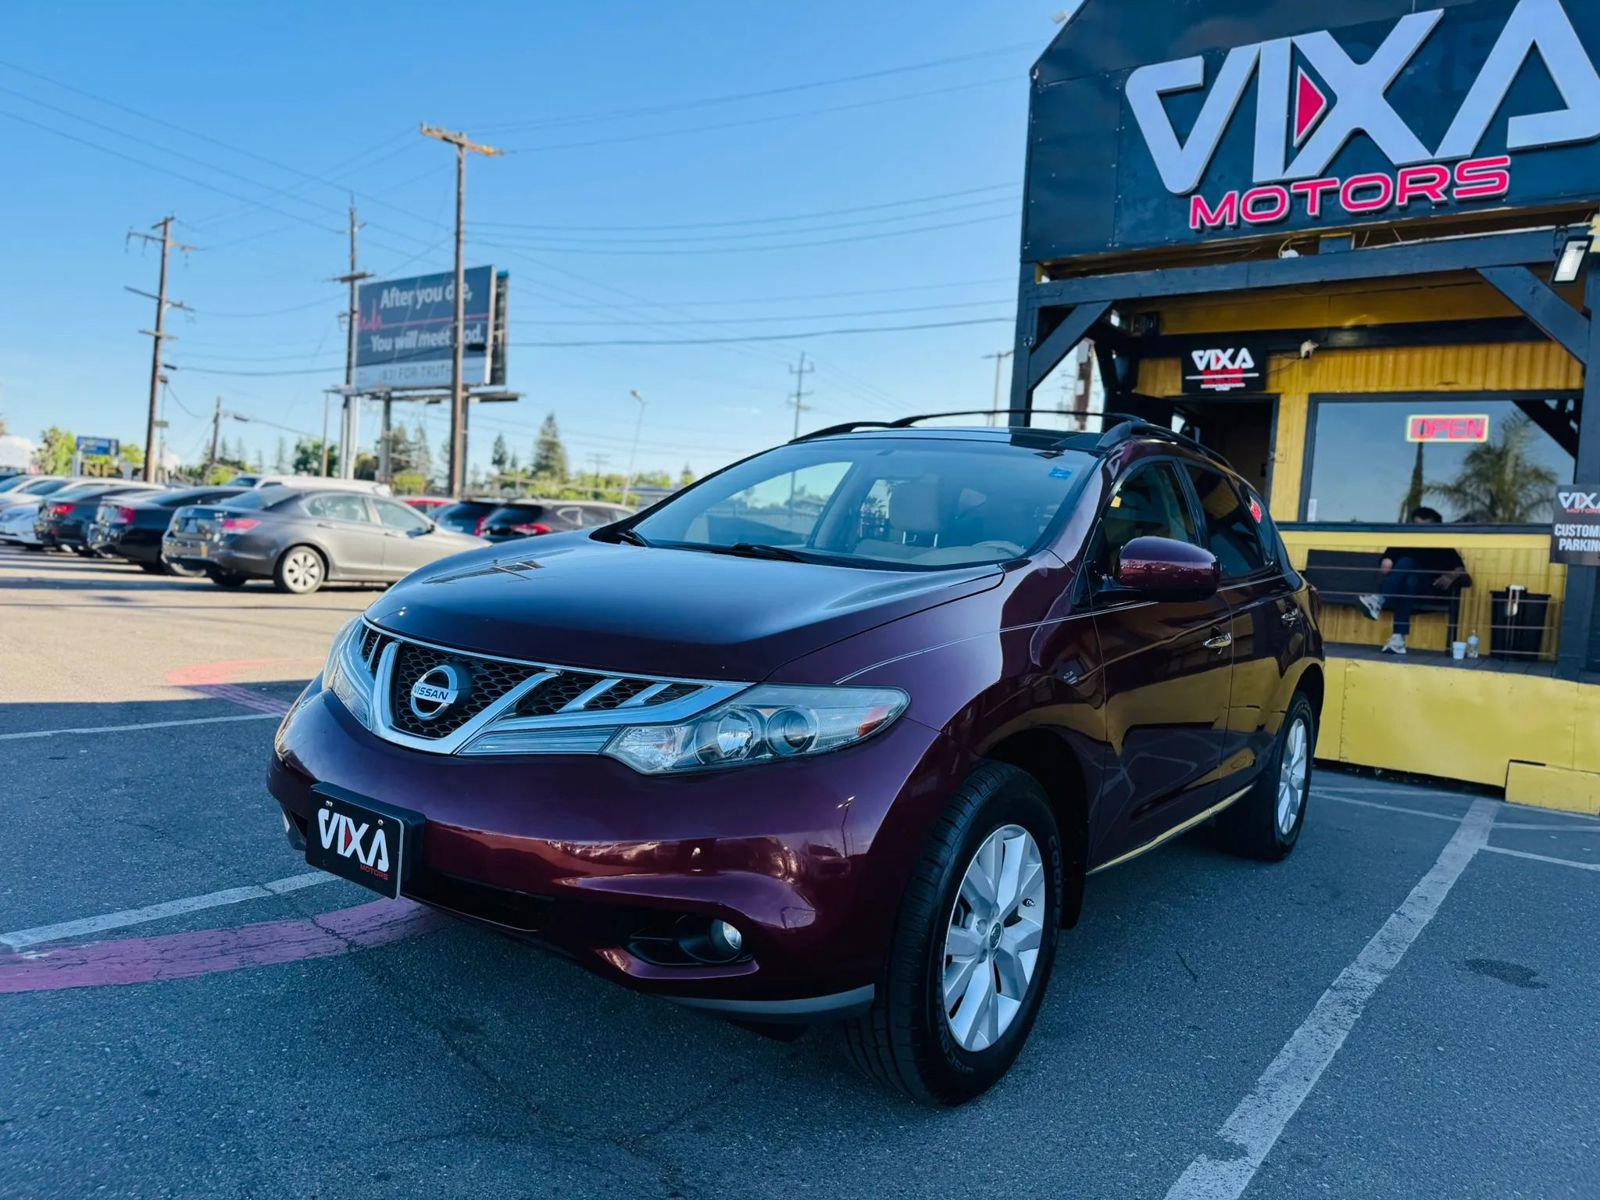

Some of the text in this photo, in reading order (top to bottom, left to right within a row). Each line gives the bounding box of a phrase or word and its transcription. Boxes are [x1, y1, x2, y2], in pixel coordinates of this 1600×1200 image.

[1125, 0, 1600, 195] VIXA
[1188, 154, 1512, 232] MOTORS
[380, 279, 473, 310] After you de,
[371, 335, 393, 352] You
[394, 329, 418, 350] will
[417, 328, 452, 347] meet
[1191, 347, 1255, 371] VIXA
[1411, 417, 1486, 439] OPEN
[1557, 492, 1600, 510] VIX
[1554, 523, 1600, 538] CUSTOM
[414, 684, 449, 701] NISSAN
[317, 808, 390, 873] VIXA
[359, 864, 391, 881] MOTORS
